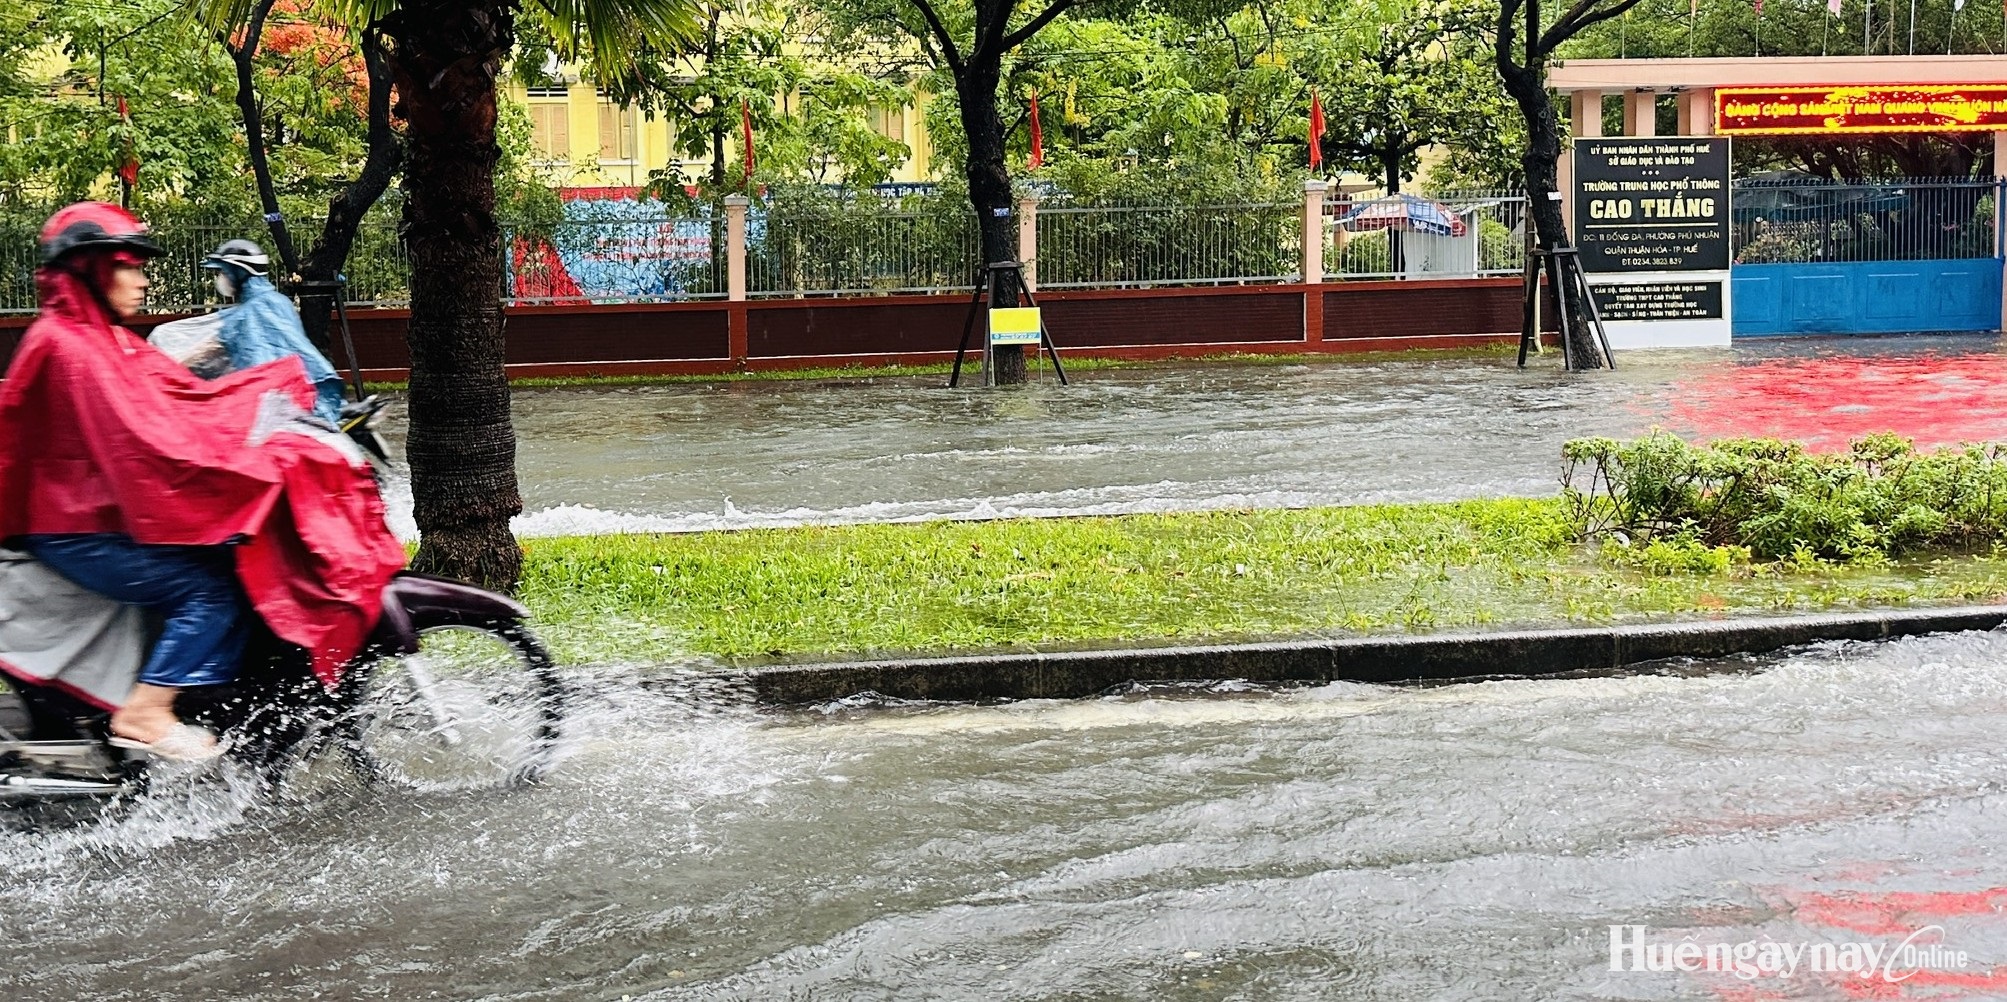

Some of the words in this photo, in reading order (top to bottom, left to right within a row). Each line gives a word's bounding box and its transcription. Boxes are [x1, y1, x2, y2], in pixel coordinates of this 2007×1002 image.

[1762, 102, 1798, 118] CỘNG
[1854, 101, 1882, 115] NAM
[1883, 101, 1926, 114] QUANG
[1602, 146, 1617, 154] BAN
[1618, 145, 1638, 154] NHÂN
[1639, 145, 1653, 154] DÂN
[1655, 144, 1679, 153] THÀNH
[1680, 143, 1695, 153] PHỐ
[1696, 143, 1710, 153] HUẾ
[1608, 155, 1619, 166] SỞ
[1620, 156, 1637, 165] GIÁO
[1639, 156, 1653, 167] DỤC
[1655, 156, 1663, 165] VÀ
[1665, 155, 1680, 165] ĐÀO
[1681, 156, 1695, 166] TẠO
[1583, 179, 1618, 191] TRƯỜNG
[1619, 181, 1648, 191] TRUNG
[1650, 181, 1669, 192] HỌC
[1670, 176, 1690, 190] PHỔ
[1691, 178, 1720, 190] THÔNG
[1590, 199, 1632, 219] CAO
[1640, 191, 1715, 218] THẮNG
[1606, 231, 1629, 241] ĐỐNG
[1645, 231, 1675, 240] PHƯỜNG
[1677, 230, 1692, 239] PHÚ
[1694, 230, 1720, 239] NHUẬN
[1604, 245, 1627, 255] QUẬN
[1628, 245, 1650, 255] THUẬN
[1652, 244, 1668, 253] HÓA
[1683, 242, 1698, 253] HUẾ
[1594, 286, 1606, 294] CÁN
[1681, 285, 1693, 293] HỌC
[1665, 292, 1683, 300] THẮNG
[1604, 301, 1622, 310] QUYẾT
[1685, 301, 1697, 309] HỌC
